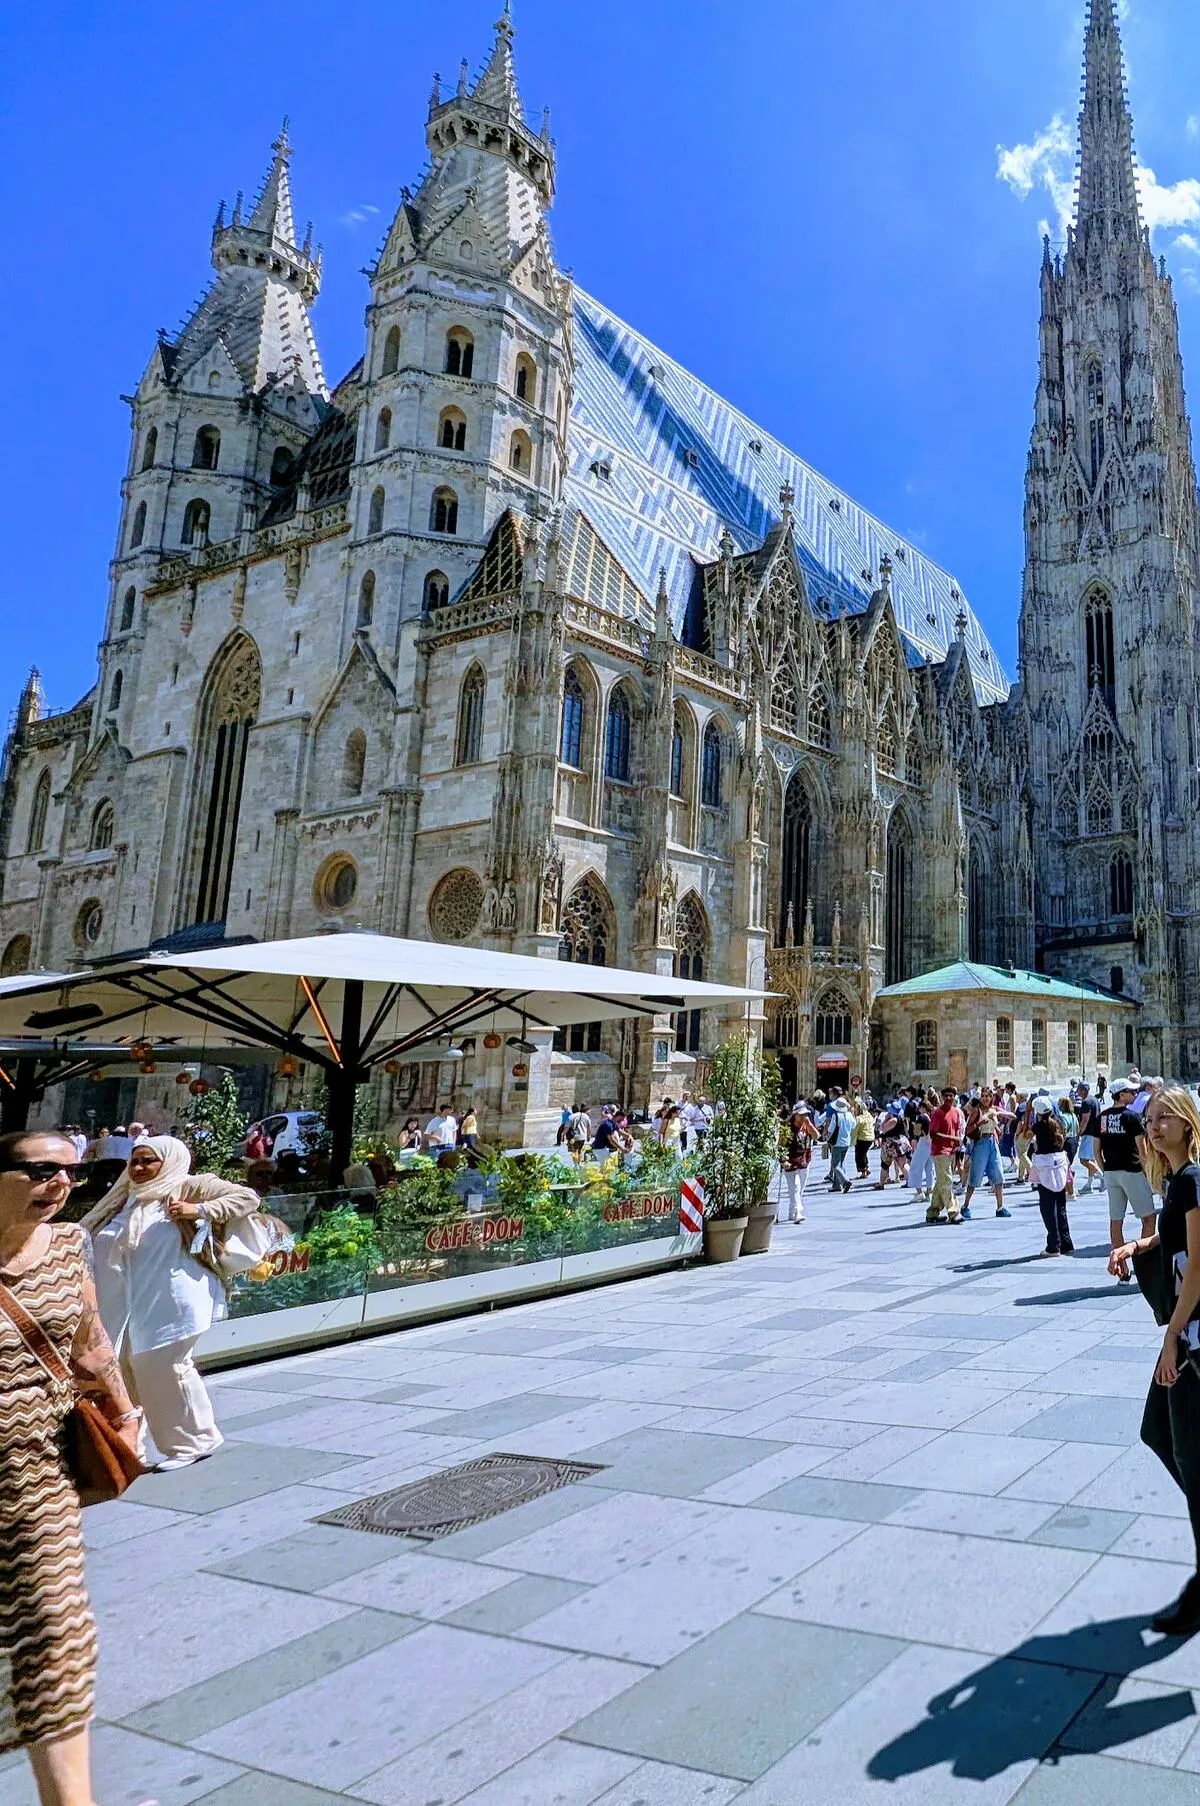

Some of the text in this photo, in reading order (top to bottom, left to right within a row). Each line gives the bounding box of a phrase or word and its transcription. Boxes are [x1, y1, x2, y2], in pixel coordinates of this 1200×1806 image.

[642, 1194, 675, 1219] DOM
[480, 1214, 525, 1244] DOM
[264, 1246, 310, 1278] OM
